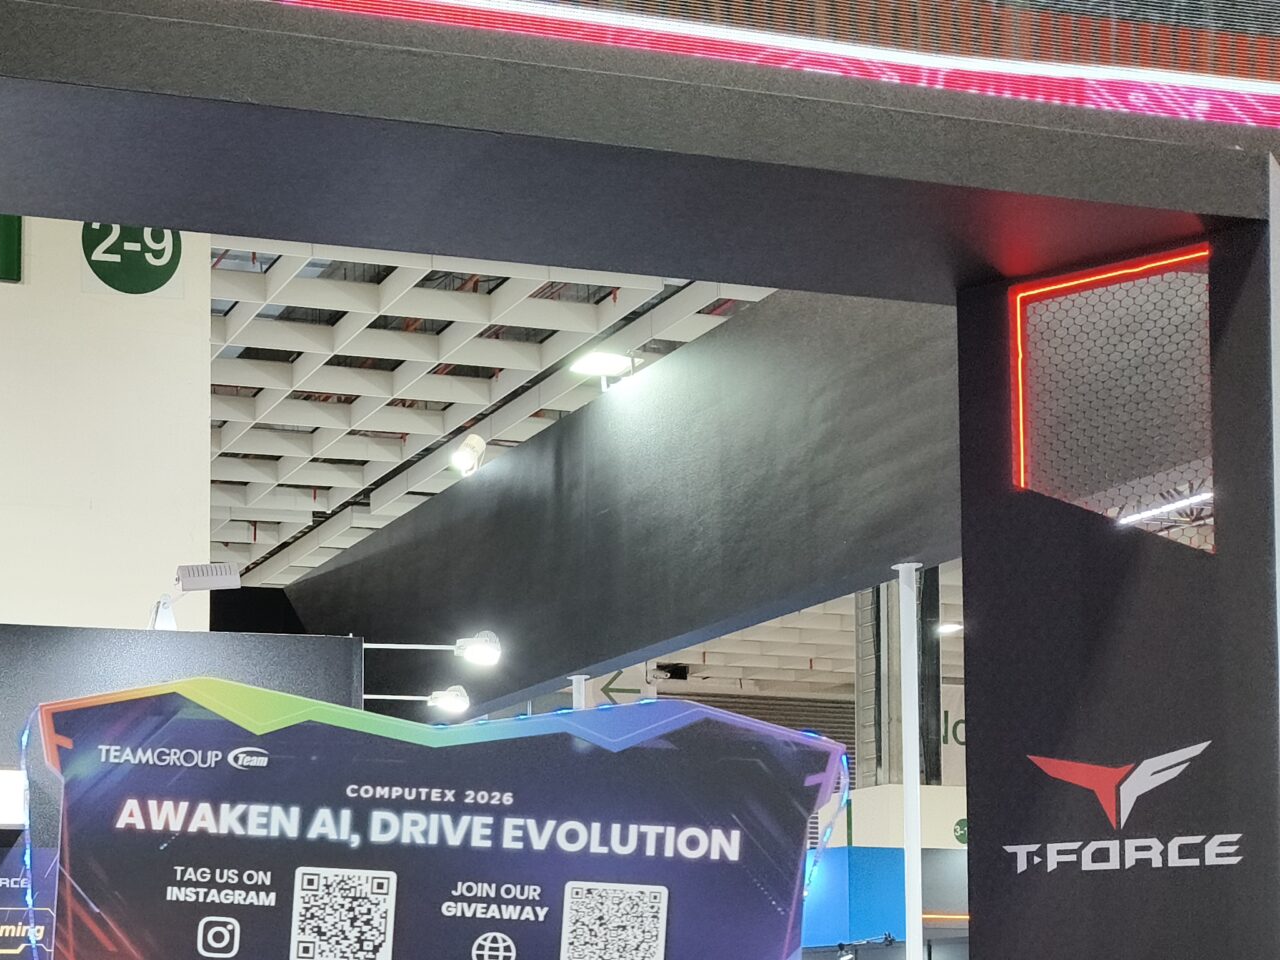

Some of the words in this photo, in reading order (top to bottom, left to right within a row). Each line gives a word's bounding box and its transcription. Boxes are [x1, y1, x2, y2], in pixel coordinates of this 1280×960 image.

[97, 745, 222, 768] TEAMGROUP
[236, 752, 270, 767] Team
[345, 785, 457, 802] COMPUTEX
[464, 790, 515, 806] 2026
[115, 799, 301, 838] AWAKEN
[307, 808, 361, 848] AI,
[369, 810, 494, 849] DRIVE
[502, 817, 741, 862] EVOLUTION
[173, 866, 211, 882] TAG
[215, 868, 240, 884] US
[243, 870, 272, 886] ON
[166, 886, 277, 907] INSTAGRAM
[451, 881, 496, 898] JOIN
[500, 883, 541, 901] OUR
[441, 901, 550, 922] GIVEAWAY
